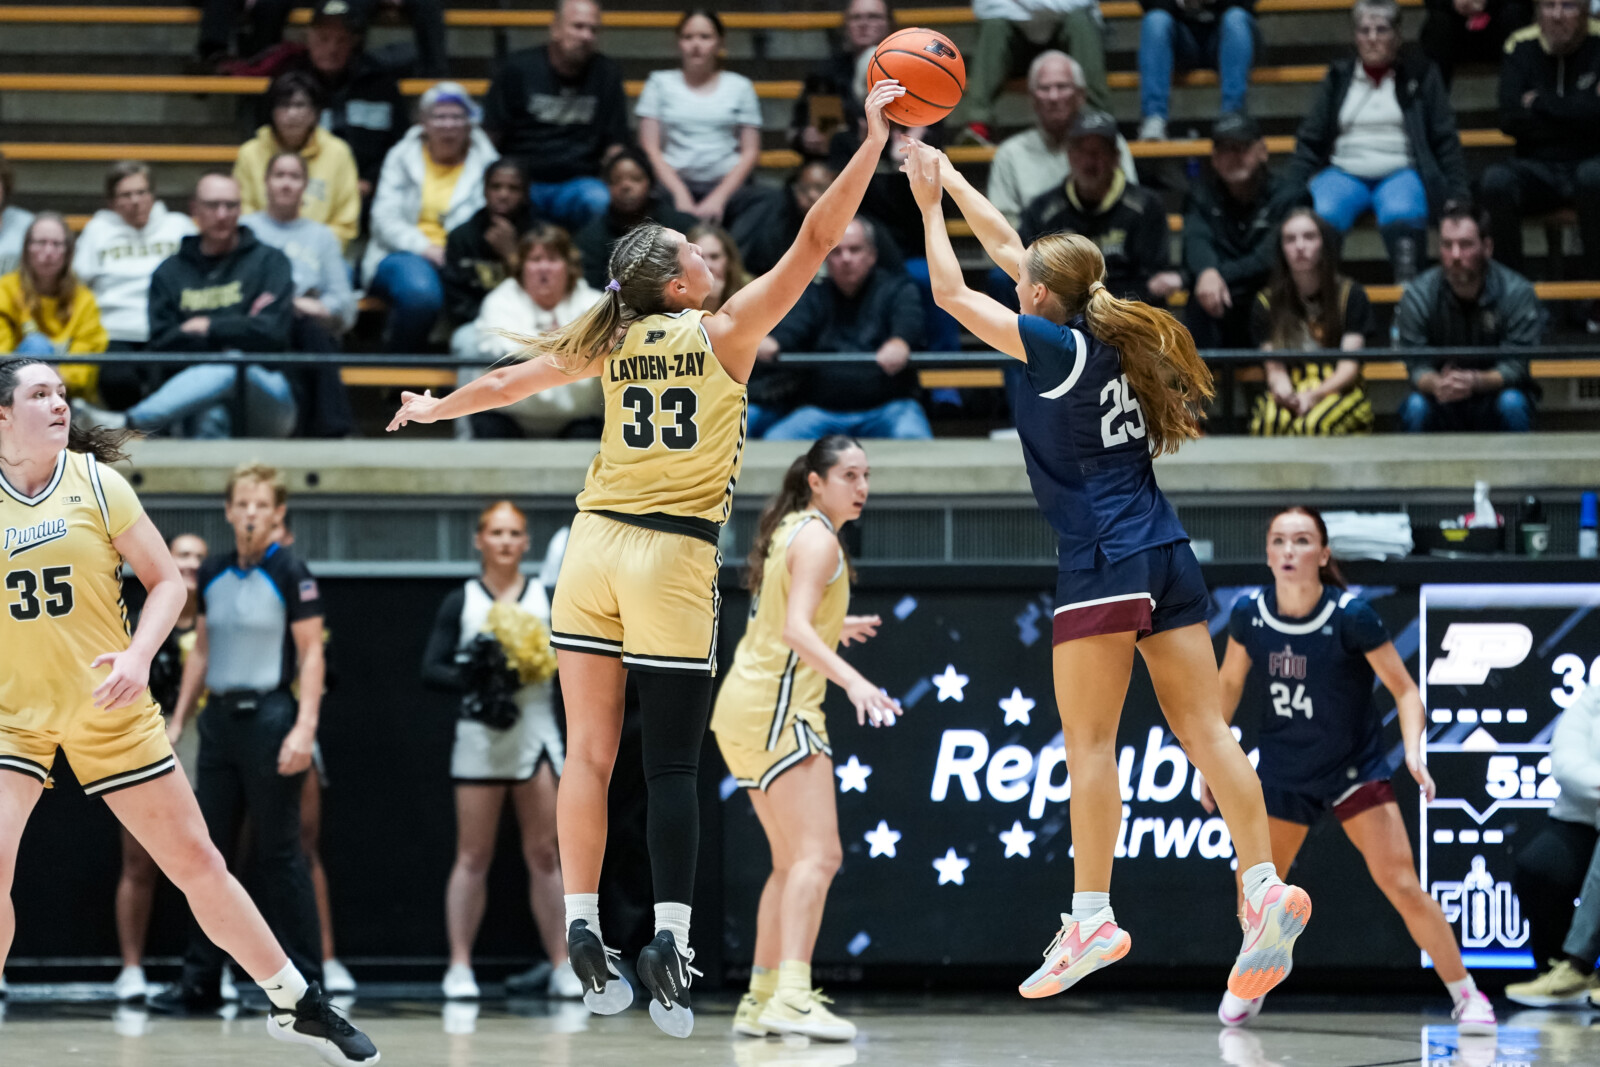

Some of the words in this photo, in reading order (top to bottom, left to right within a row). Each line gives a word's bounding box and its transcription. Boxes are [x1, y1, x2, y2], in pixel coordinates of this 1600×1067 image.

[644, 329, 667, 345] P
[610, 351, 706, 383] LAYDEN-ZAY
[621, 385, 699, 452] 33
[1099, 373, 1146, 449] 25
[3, 517, 68, 551] Purdue
[5, 564, 75, 622] 35
[1427, 622, 1534, 685] P
[1269, 681, 1314, 720] 24
